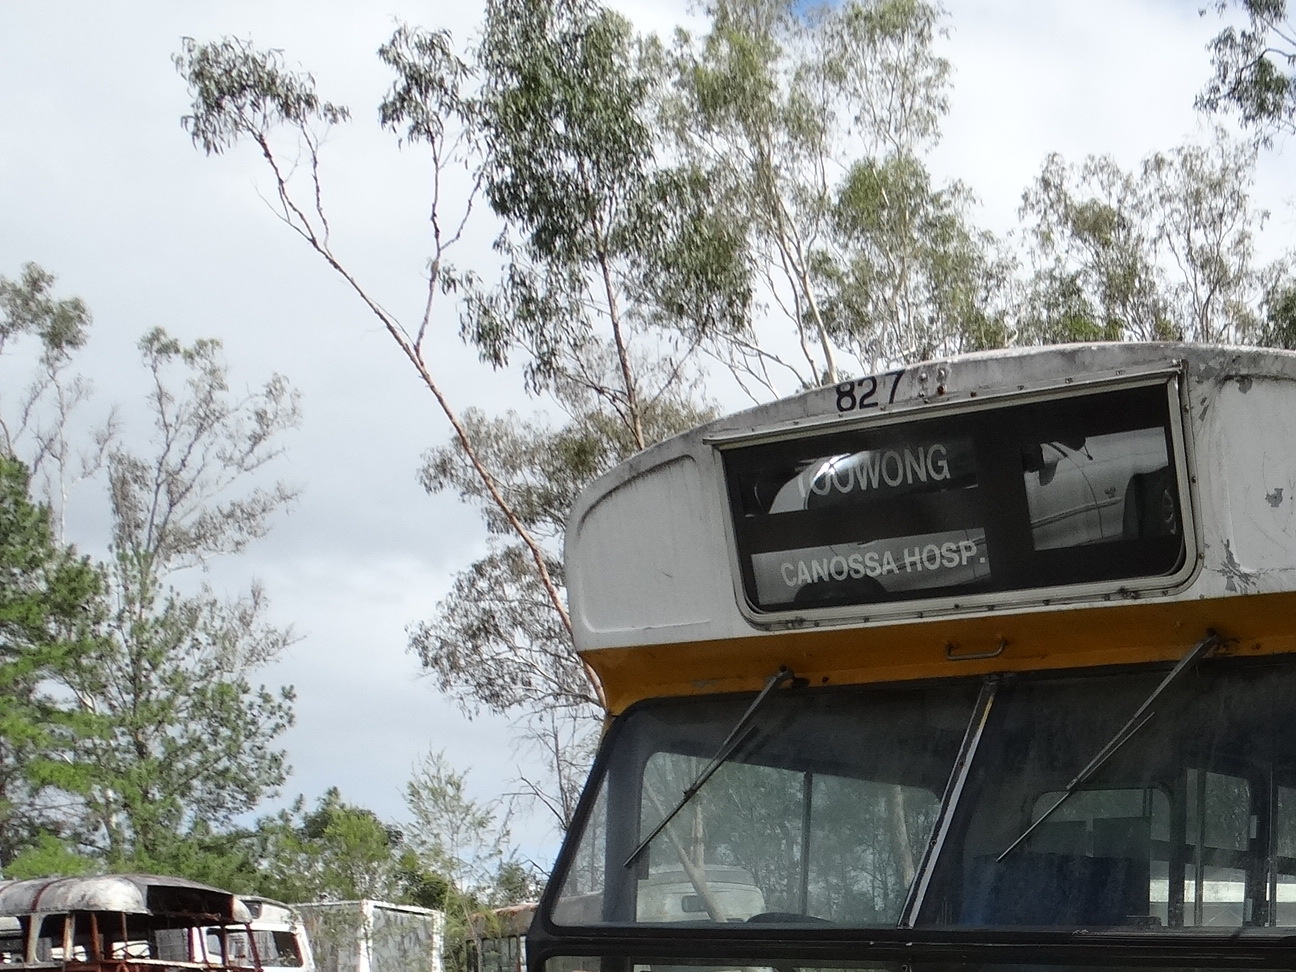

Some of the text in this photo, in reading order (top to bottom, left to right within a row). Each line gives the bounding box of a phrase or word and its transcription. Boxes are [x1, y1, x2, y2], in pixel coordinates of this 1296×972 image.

[836, 369, 905, 412] 827
[780, 540, 986, 587] CANOSSA HOSP.
